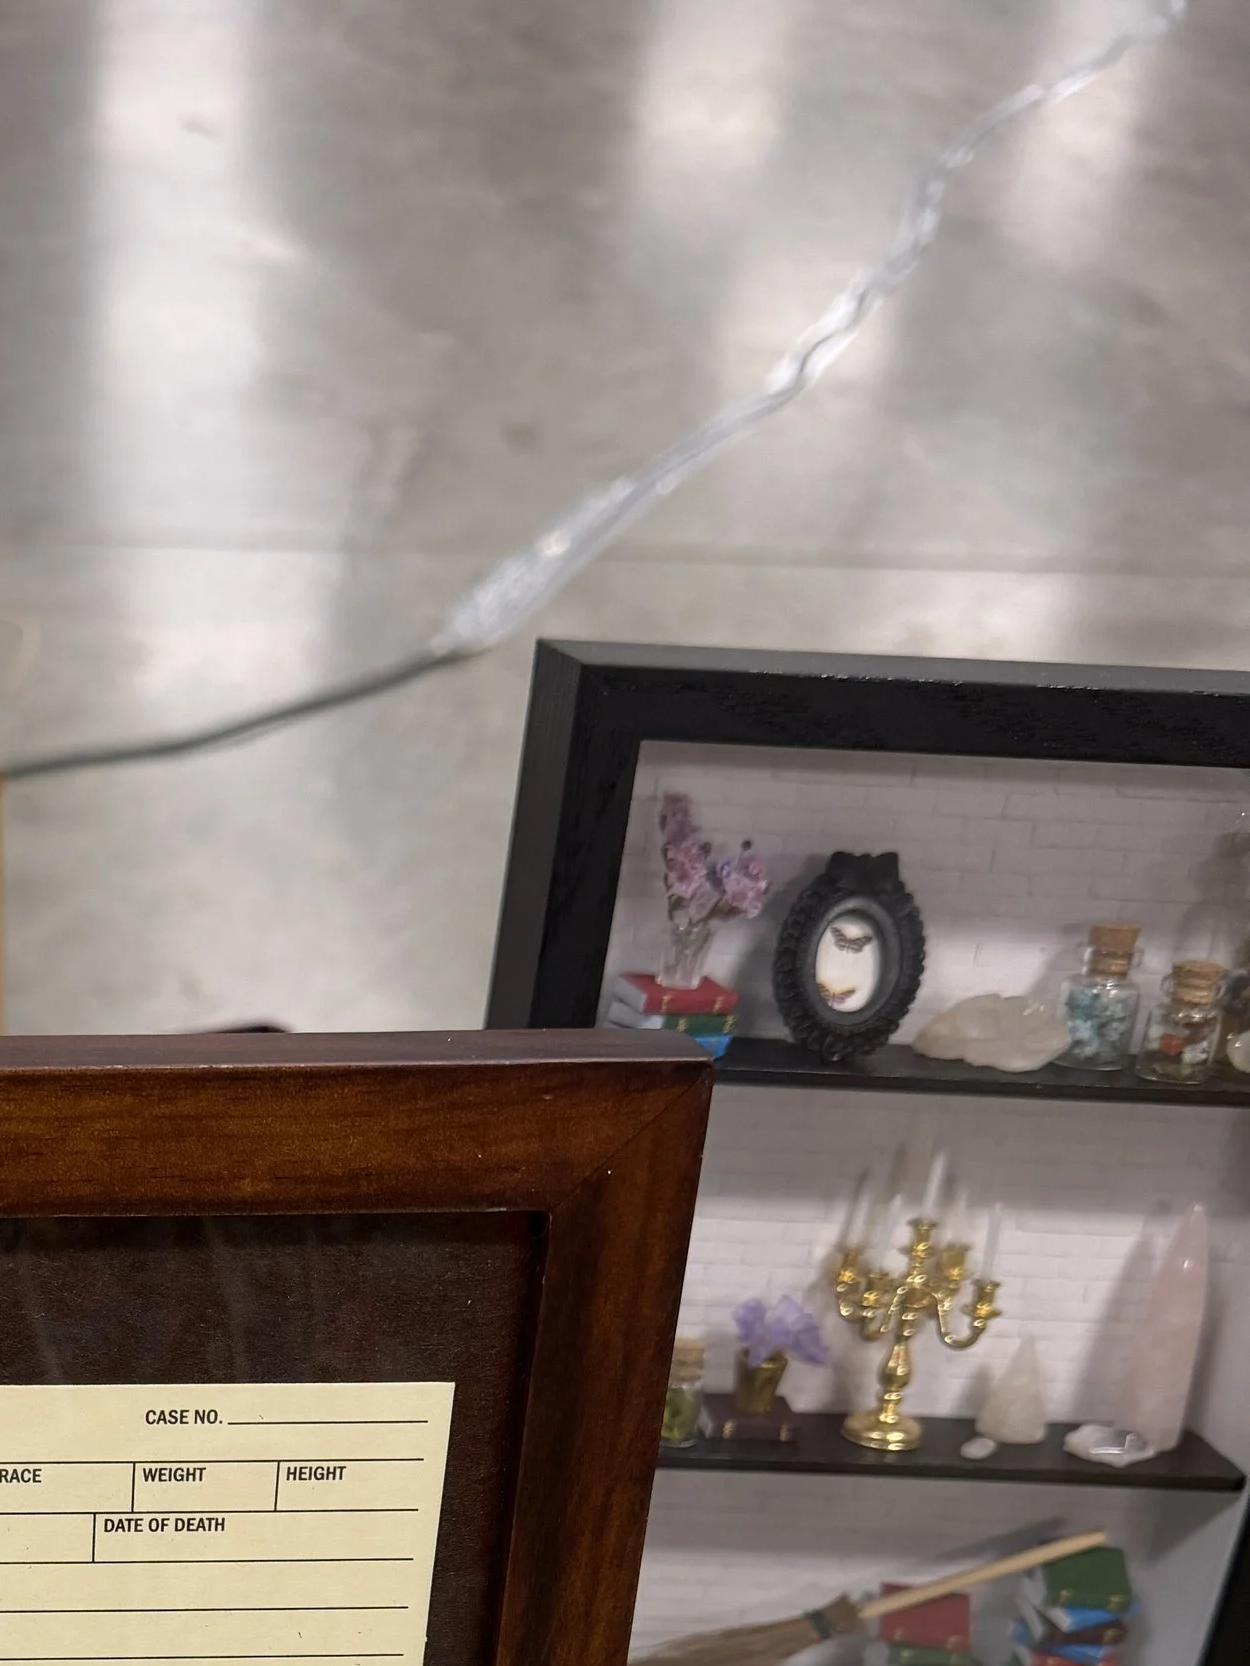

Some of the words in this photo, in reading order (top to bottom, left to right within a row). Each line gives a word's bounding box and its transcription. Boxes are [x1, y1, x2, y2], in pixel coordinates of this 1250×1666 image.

[145, 1409, 190, 1425] CASE
[194, 1408, 223, 1425] NO.
[142, 1467, 207, 1483] WEIGHT
[286, 1465, 347, 1481] HEIGHT
[103, 1517, 144, 1533] DATE
[148, 1517, 171, 1533] OF
[174, 1517, 226, 1533] DEATH
